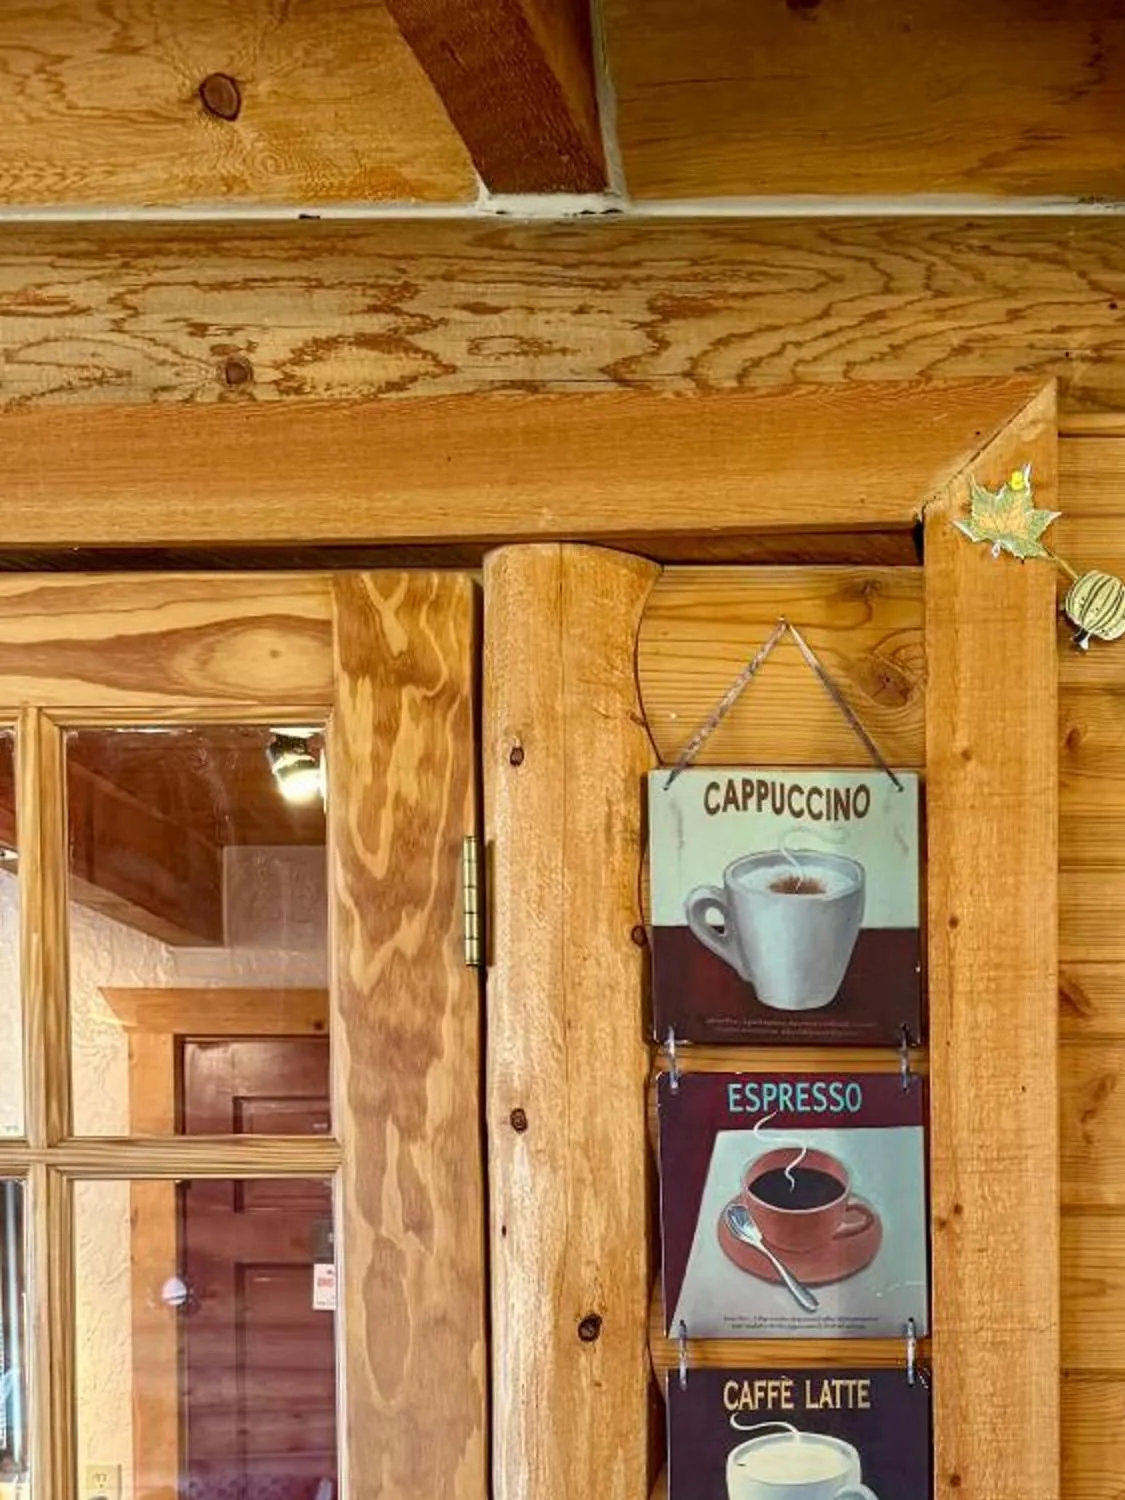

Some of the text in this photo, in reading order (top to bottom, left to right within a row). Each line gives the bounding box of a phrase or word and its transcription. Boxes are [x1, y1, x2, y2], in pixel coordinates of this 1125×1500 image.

[704, 778, 871, 822] CAPPUCCINO
[728, 1082, 863, 1113] ESPRESSO
[723, 1376, 871, 1411] CAFFÈ LATTE
